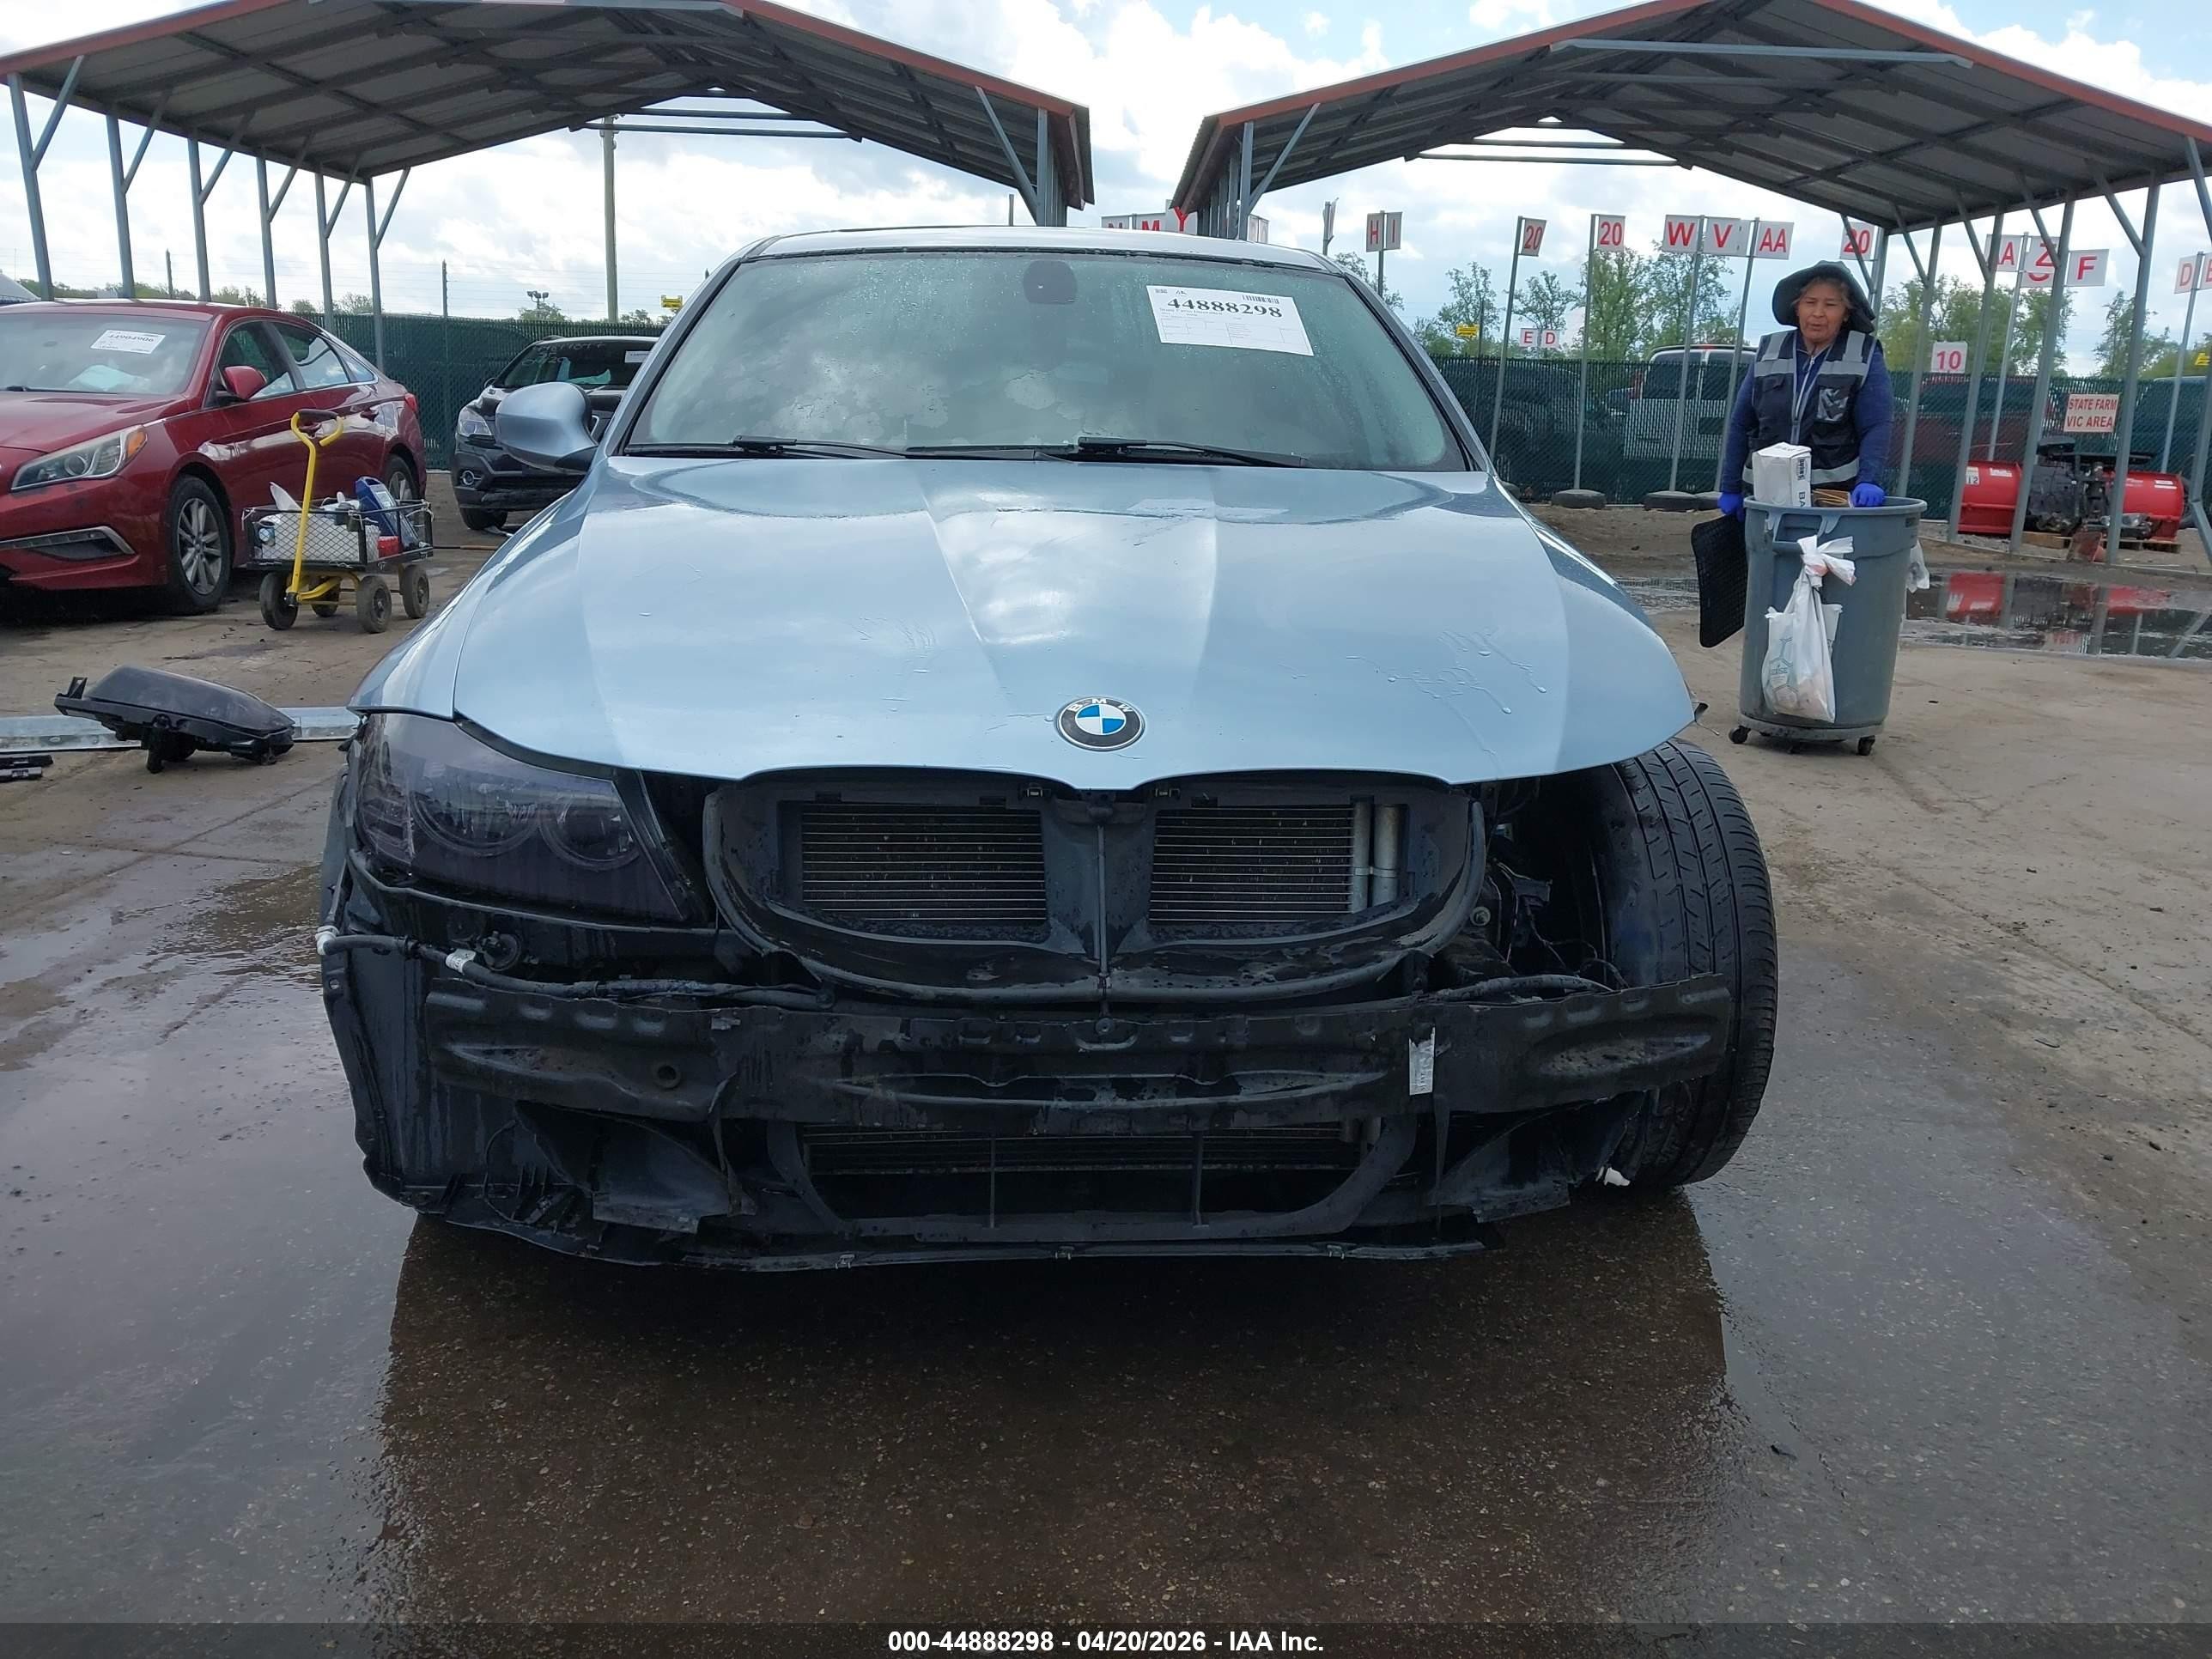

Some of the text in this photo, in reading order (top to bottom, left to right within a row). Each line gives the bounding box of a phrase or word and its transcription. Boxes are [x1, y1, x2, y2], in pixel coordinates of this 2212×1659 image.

[1173, 206, 1188, 232] Y
[1370, 219, 1379, 245] H
[1524, 225, 1544, 250] 20
[1600, 222, 1622, 246] 20
[1668, 221, 1696, 246] W
[1713, 223, 1734, 248] V
[1759, 228, 1787, 253] AA
[2076, 255, 2098, 281] F
[2179, 262, 2193, 287] D
[1167, 298, 1283, 319] 44888298
[1523, 331, 1534, 343] E
[1546, 331, 1556, 344] D
[1936, 350, 1961, 370] 10
[2069, 398, 2118, 410] STATE FARM
[2067, 416, 2112, 428] VIC AREA
[1067, 697, 1133, 713] BMW
